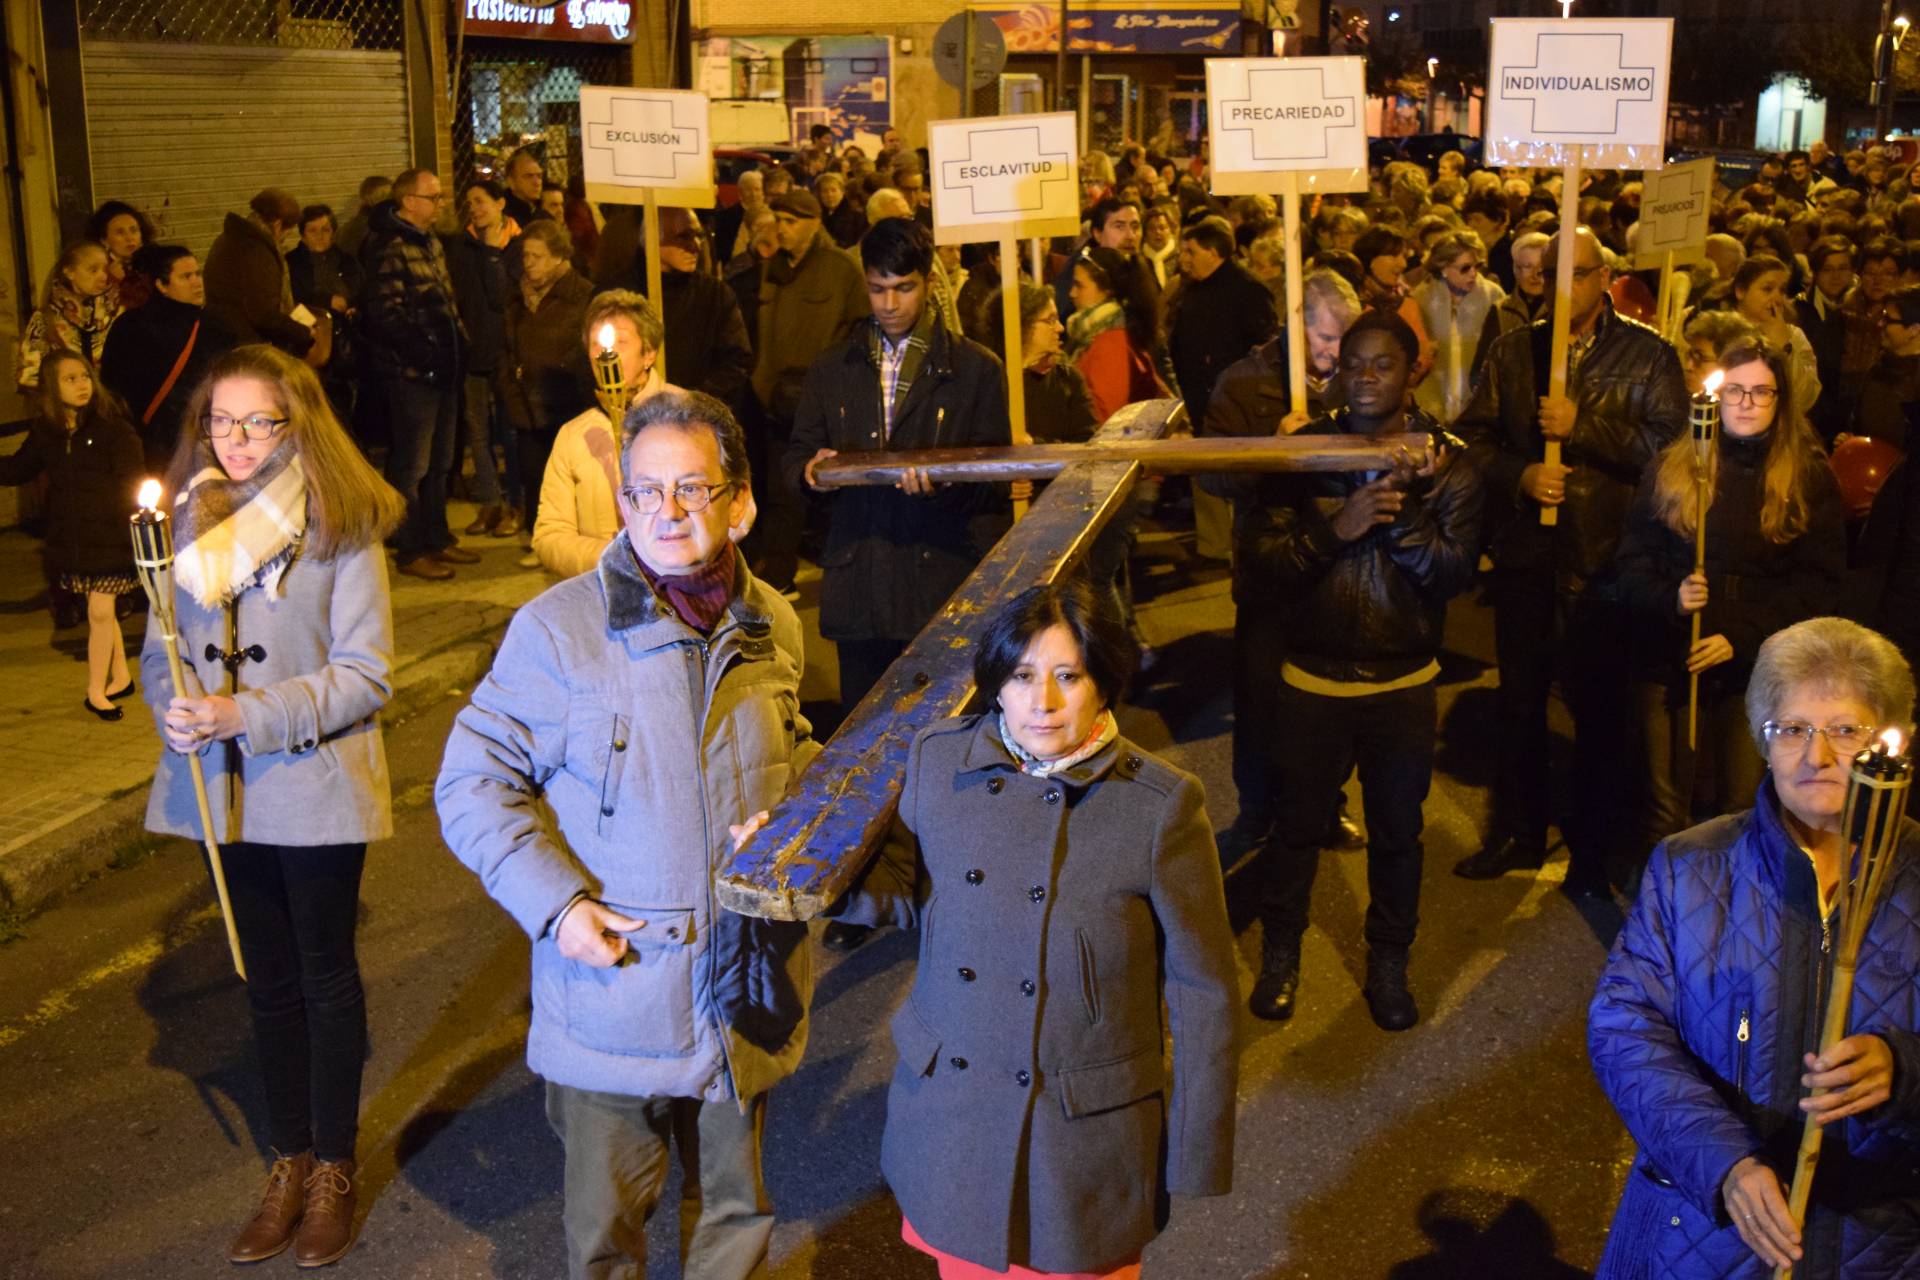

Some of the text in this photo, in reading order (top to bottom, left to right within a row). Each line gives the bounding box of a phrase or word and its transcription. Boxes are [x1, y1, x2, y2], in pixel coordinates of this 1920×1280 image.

[1504, 76, 1651, 91] INDIVIDUALISMO
[1232, 105, 1345, 120] PRECARIEDAD
[606, 130, 681, 145] EXCLUSIÓN
[960, 161, 1053, 179] ESCLAVITUD
